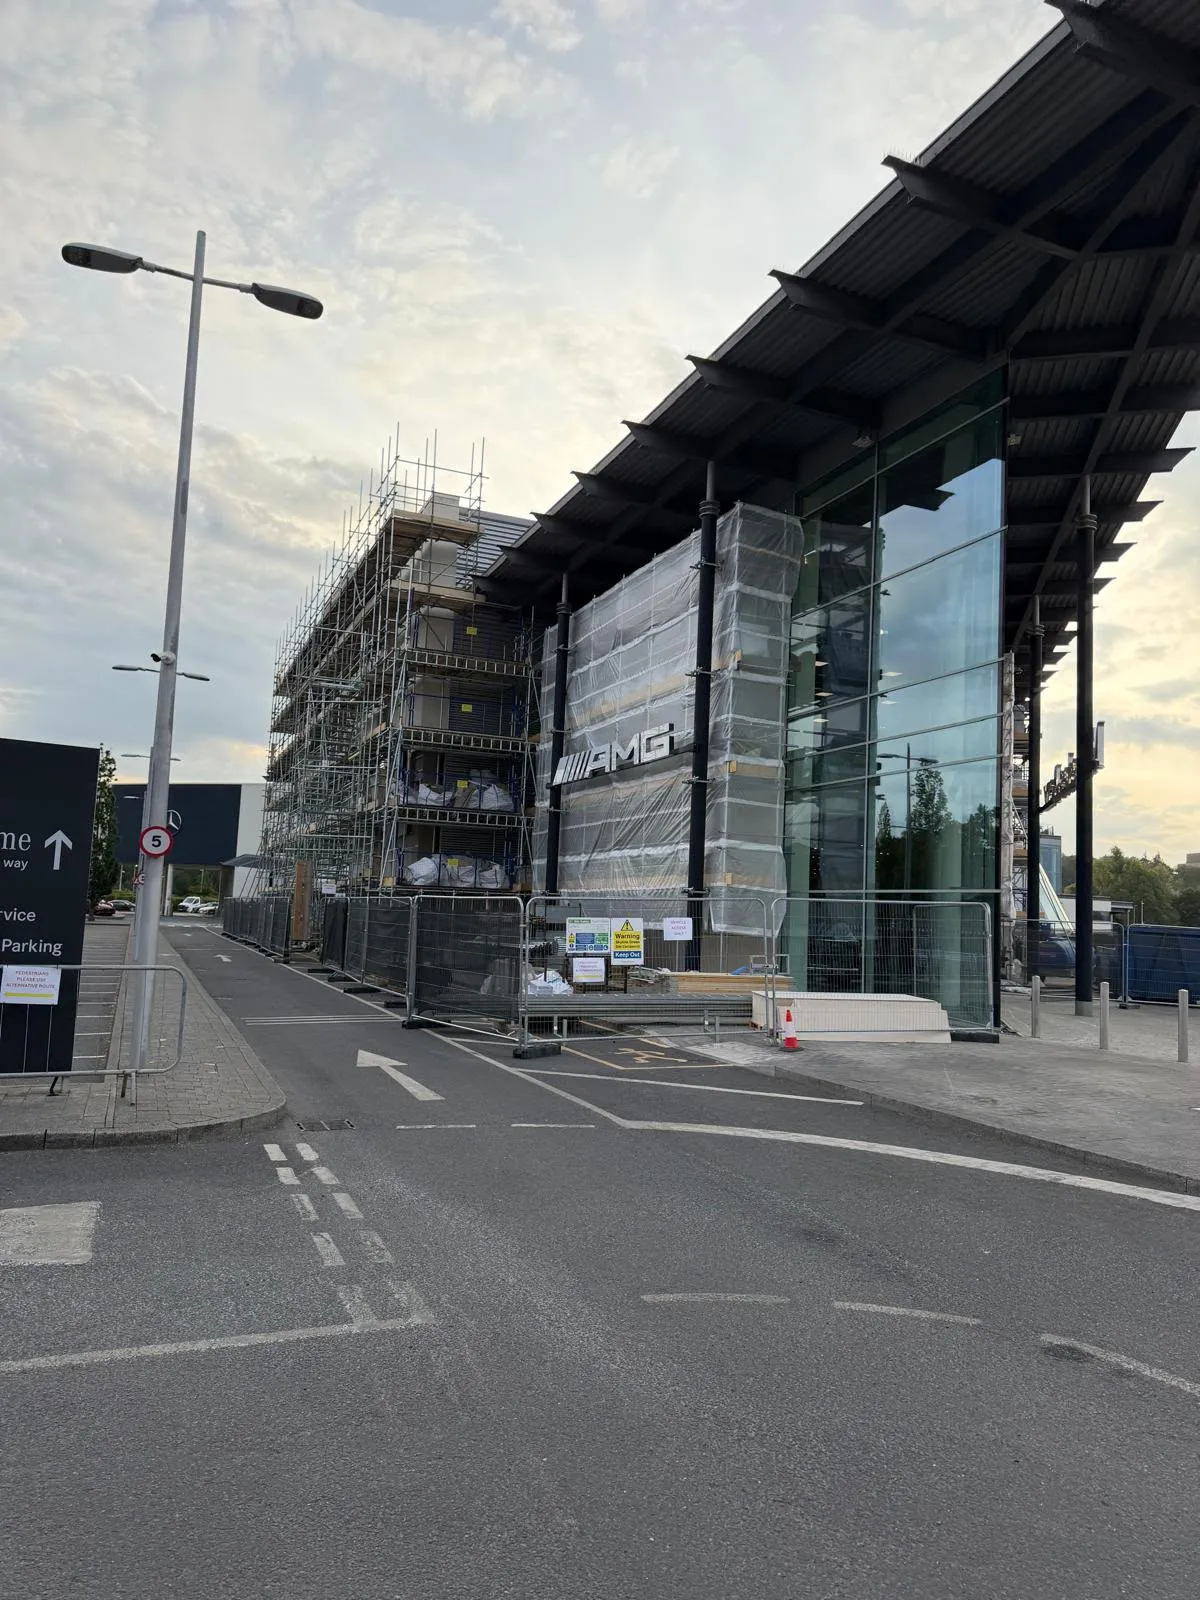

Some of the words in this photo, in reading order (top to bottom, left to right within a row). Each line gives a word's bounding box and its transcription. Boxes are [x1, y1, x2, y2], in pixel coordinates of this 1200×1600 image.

[151, 835, 162, 848] 5
[3, 859, 29, 871] way
[615, 933, 640, 941] Warning
[1, 938, 63, 957] Parking
